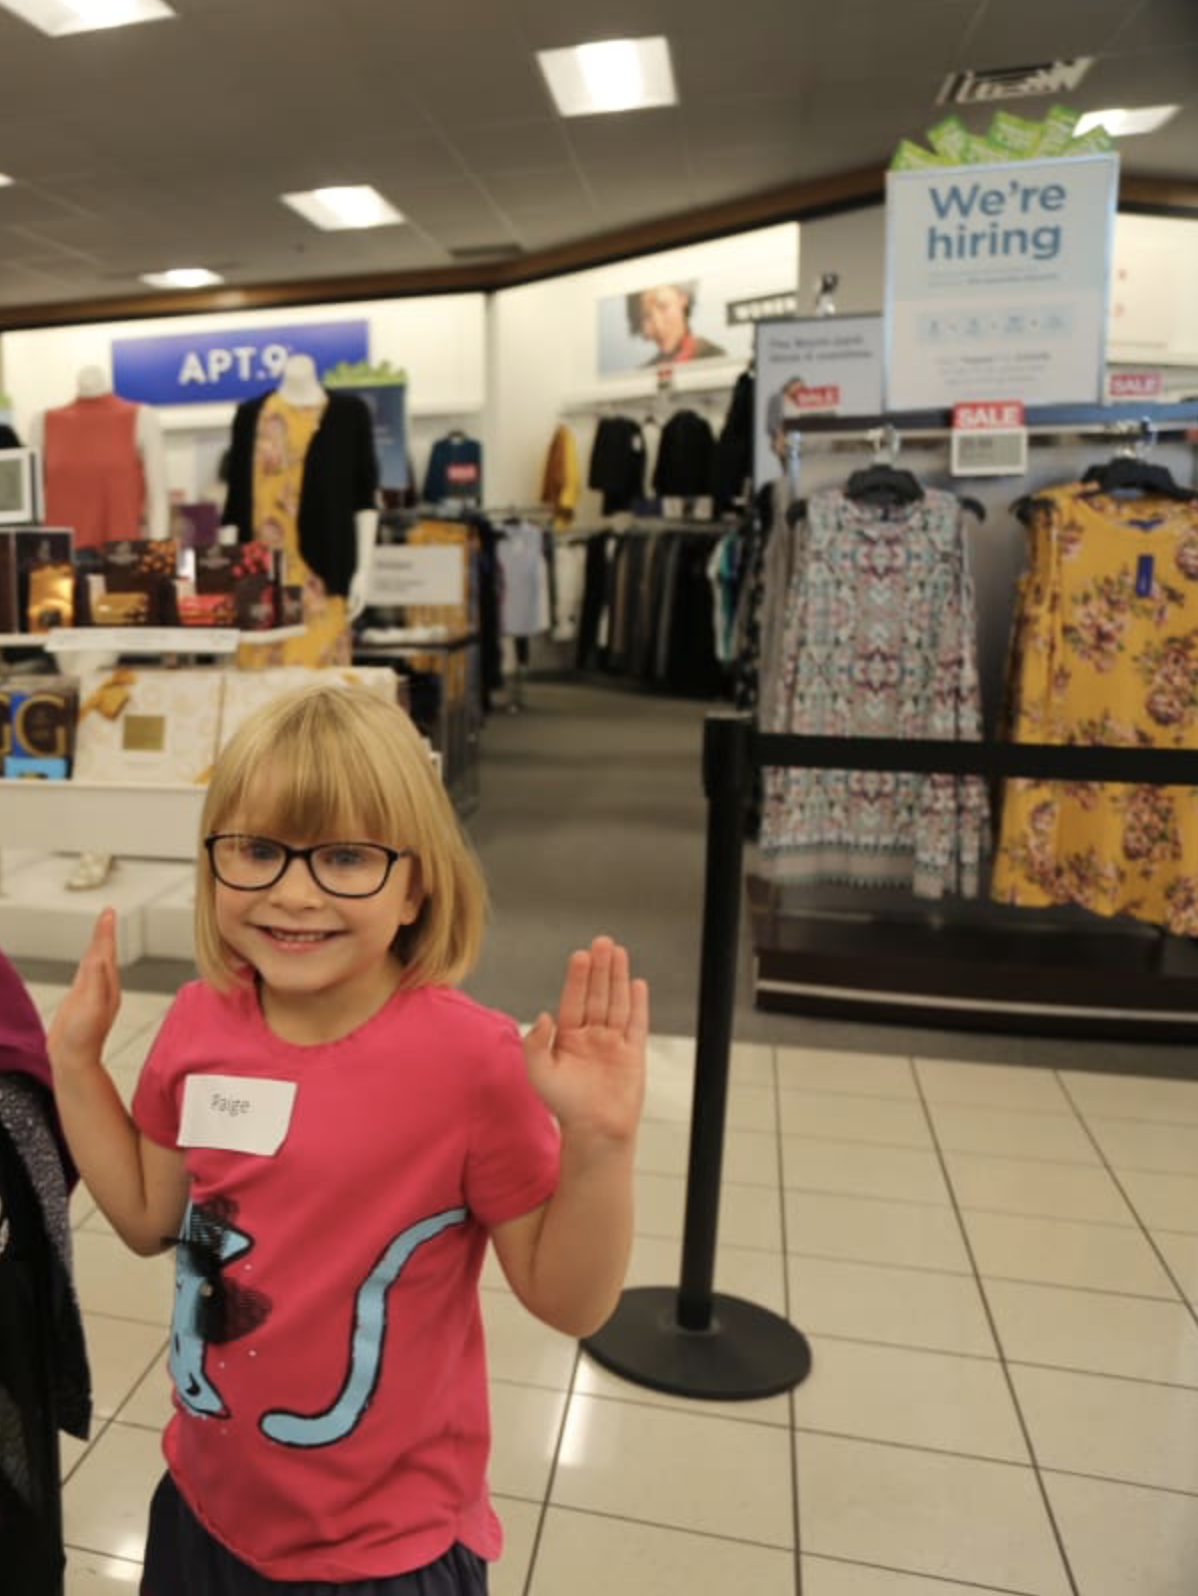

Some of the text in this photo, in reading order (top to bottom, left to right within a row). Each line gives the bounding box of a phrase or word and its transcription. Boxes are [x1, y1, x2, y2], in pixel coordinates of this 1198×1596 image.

[928, 179, 1067, 221] We’re
[927, 221, 1062, 261] hiring
[177, 344, 290, 385] APT.9
[956, 406, 1019, 428] SALE
